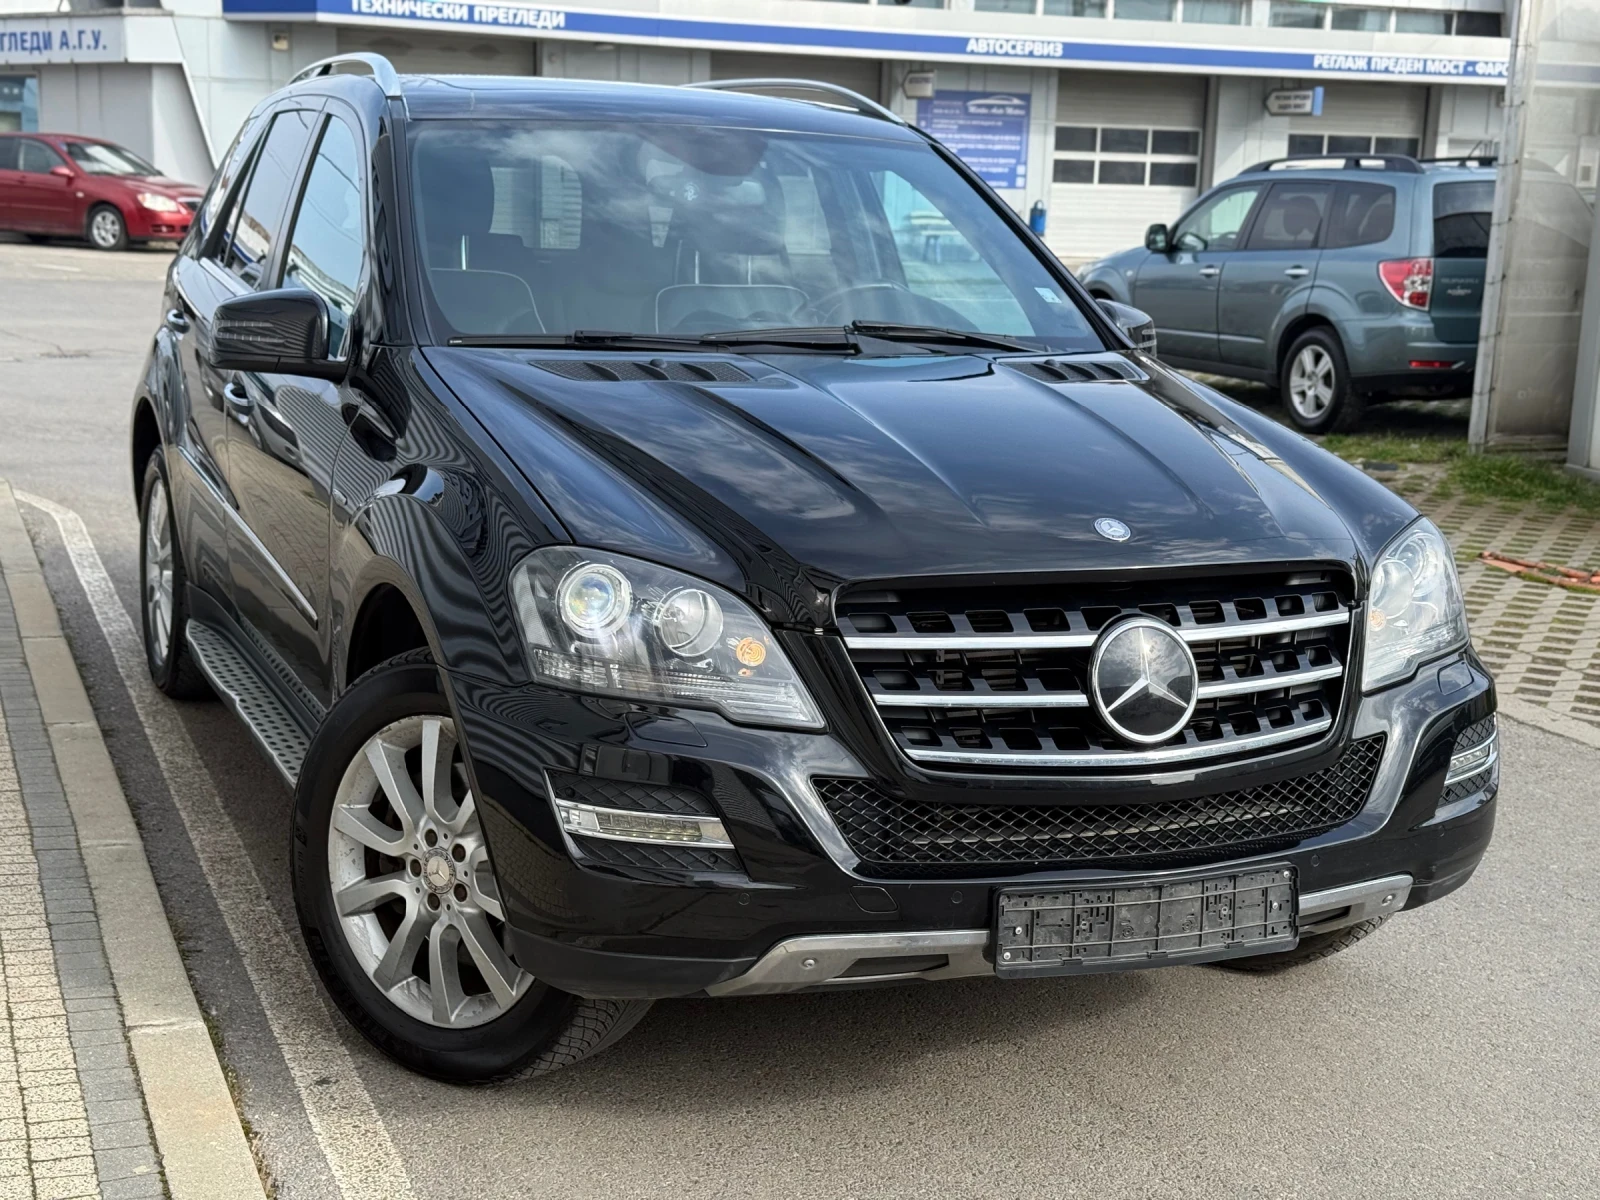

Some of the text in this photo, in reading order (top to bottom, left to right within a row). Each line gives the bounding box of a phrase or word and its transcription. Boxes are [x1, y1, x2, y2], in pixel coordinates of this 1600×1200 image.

[473, 5, 566, 29] ПРЕГЛЕДИ
[59, 29, 108, 51] А.Г.У.
[966, 37, 1064, 57] АВТОСЕРВИЗ
[1313, 54, 1369, 71] РЕГЛАЖ
[1371, 57, 1425, 74] ПРЕДЕН
[1426, 60, 1467, 75] МОСТ
